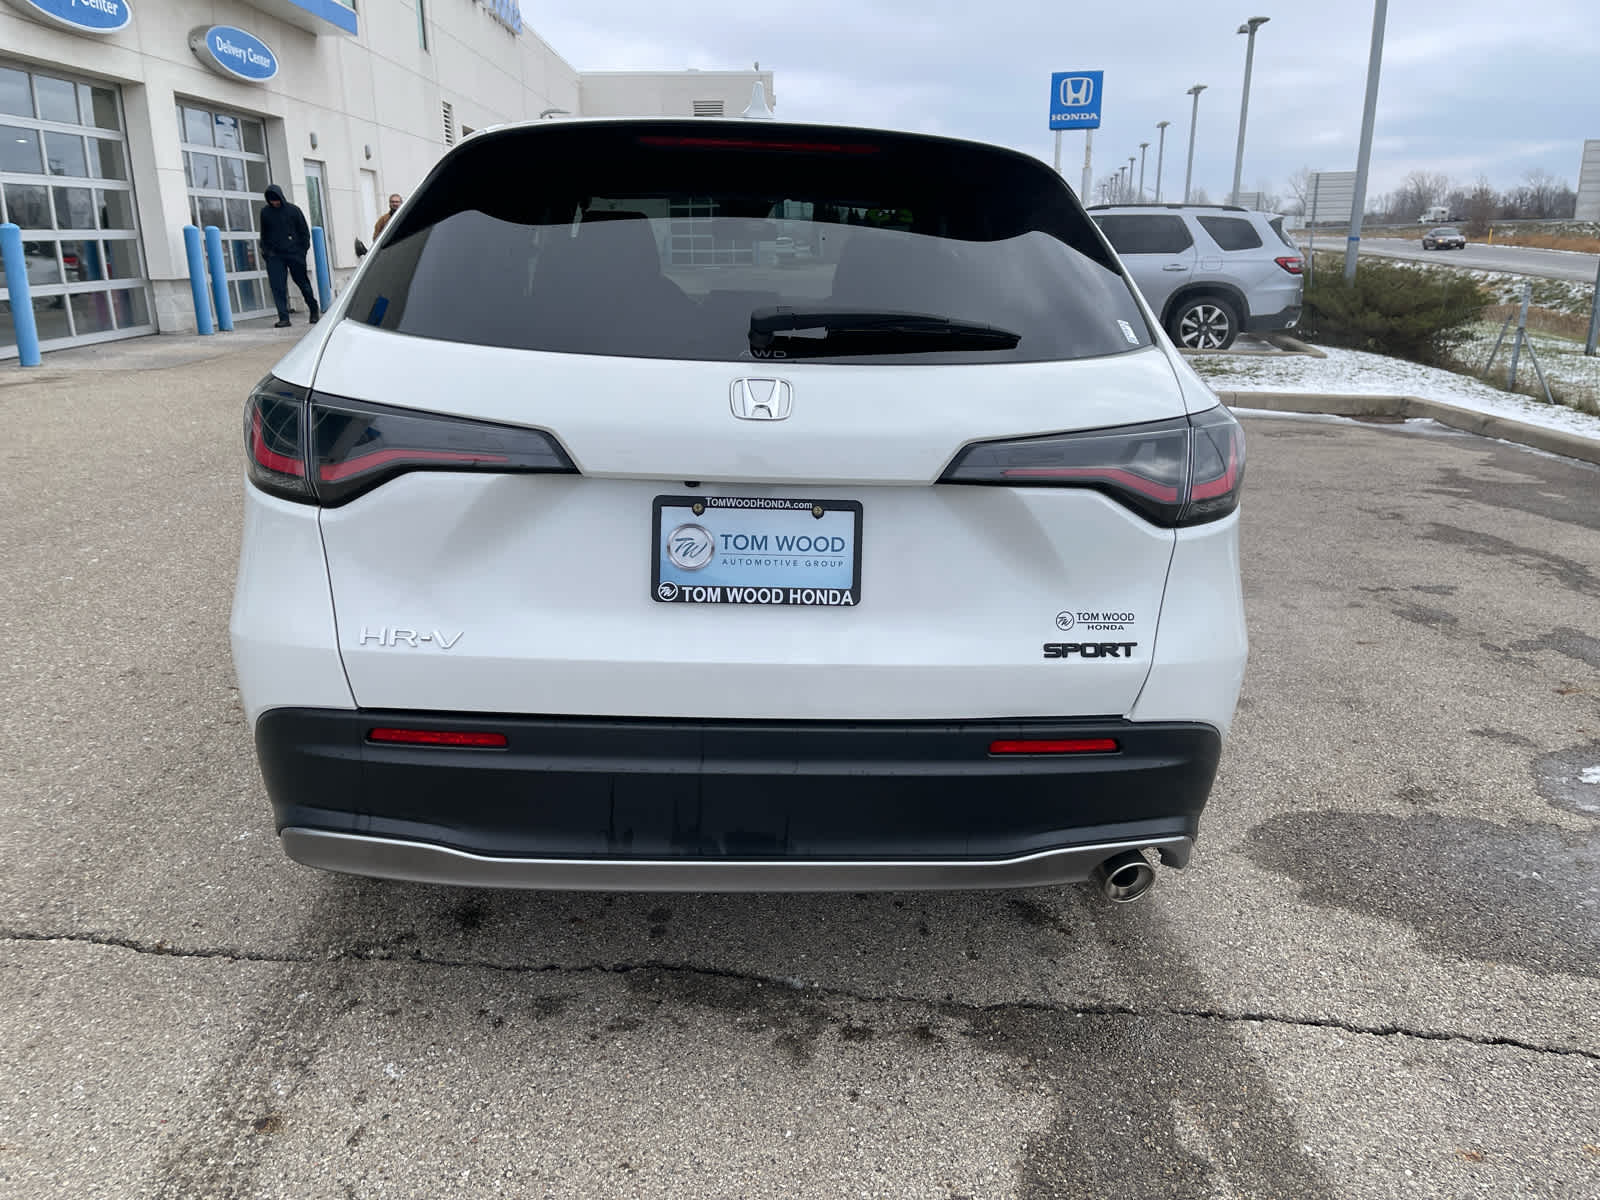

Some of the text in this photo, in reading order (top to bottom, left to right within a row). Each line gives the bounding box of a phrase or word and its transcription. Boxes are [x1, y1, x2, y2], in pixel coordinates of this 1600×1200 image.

[216, 36, 271, 68] Delivery Center
[1051, 112, 1098, 121] HONDA
[737, 349, 787, 361] AWD
[720, 534, 845, 553] TOM WOOD
[722, 558, 844, 568] AUTOMOTIVE GROUP
[682, 586, 854, 606] TOM WOOD HONDA
[1077, 612, 1135, 621] TOM WOOD
[359, 627, 464, 650] HR-V
[1043, 642, 1138, 658] SPORT
